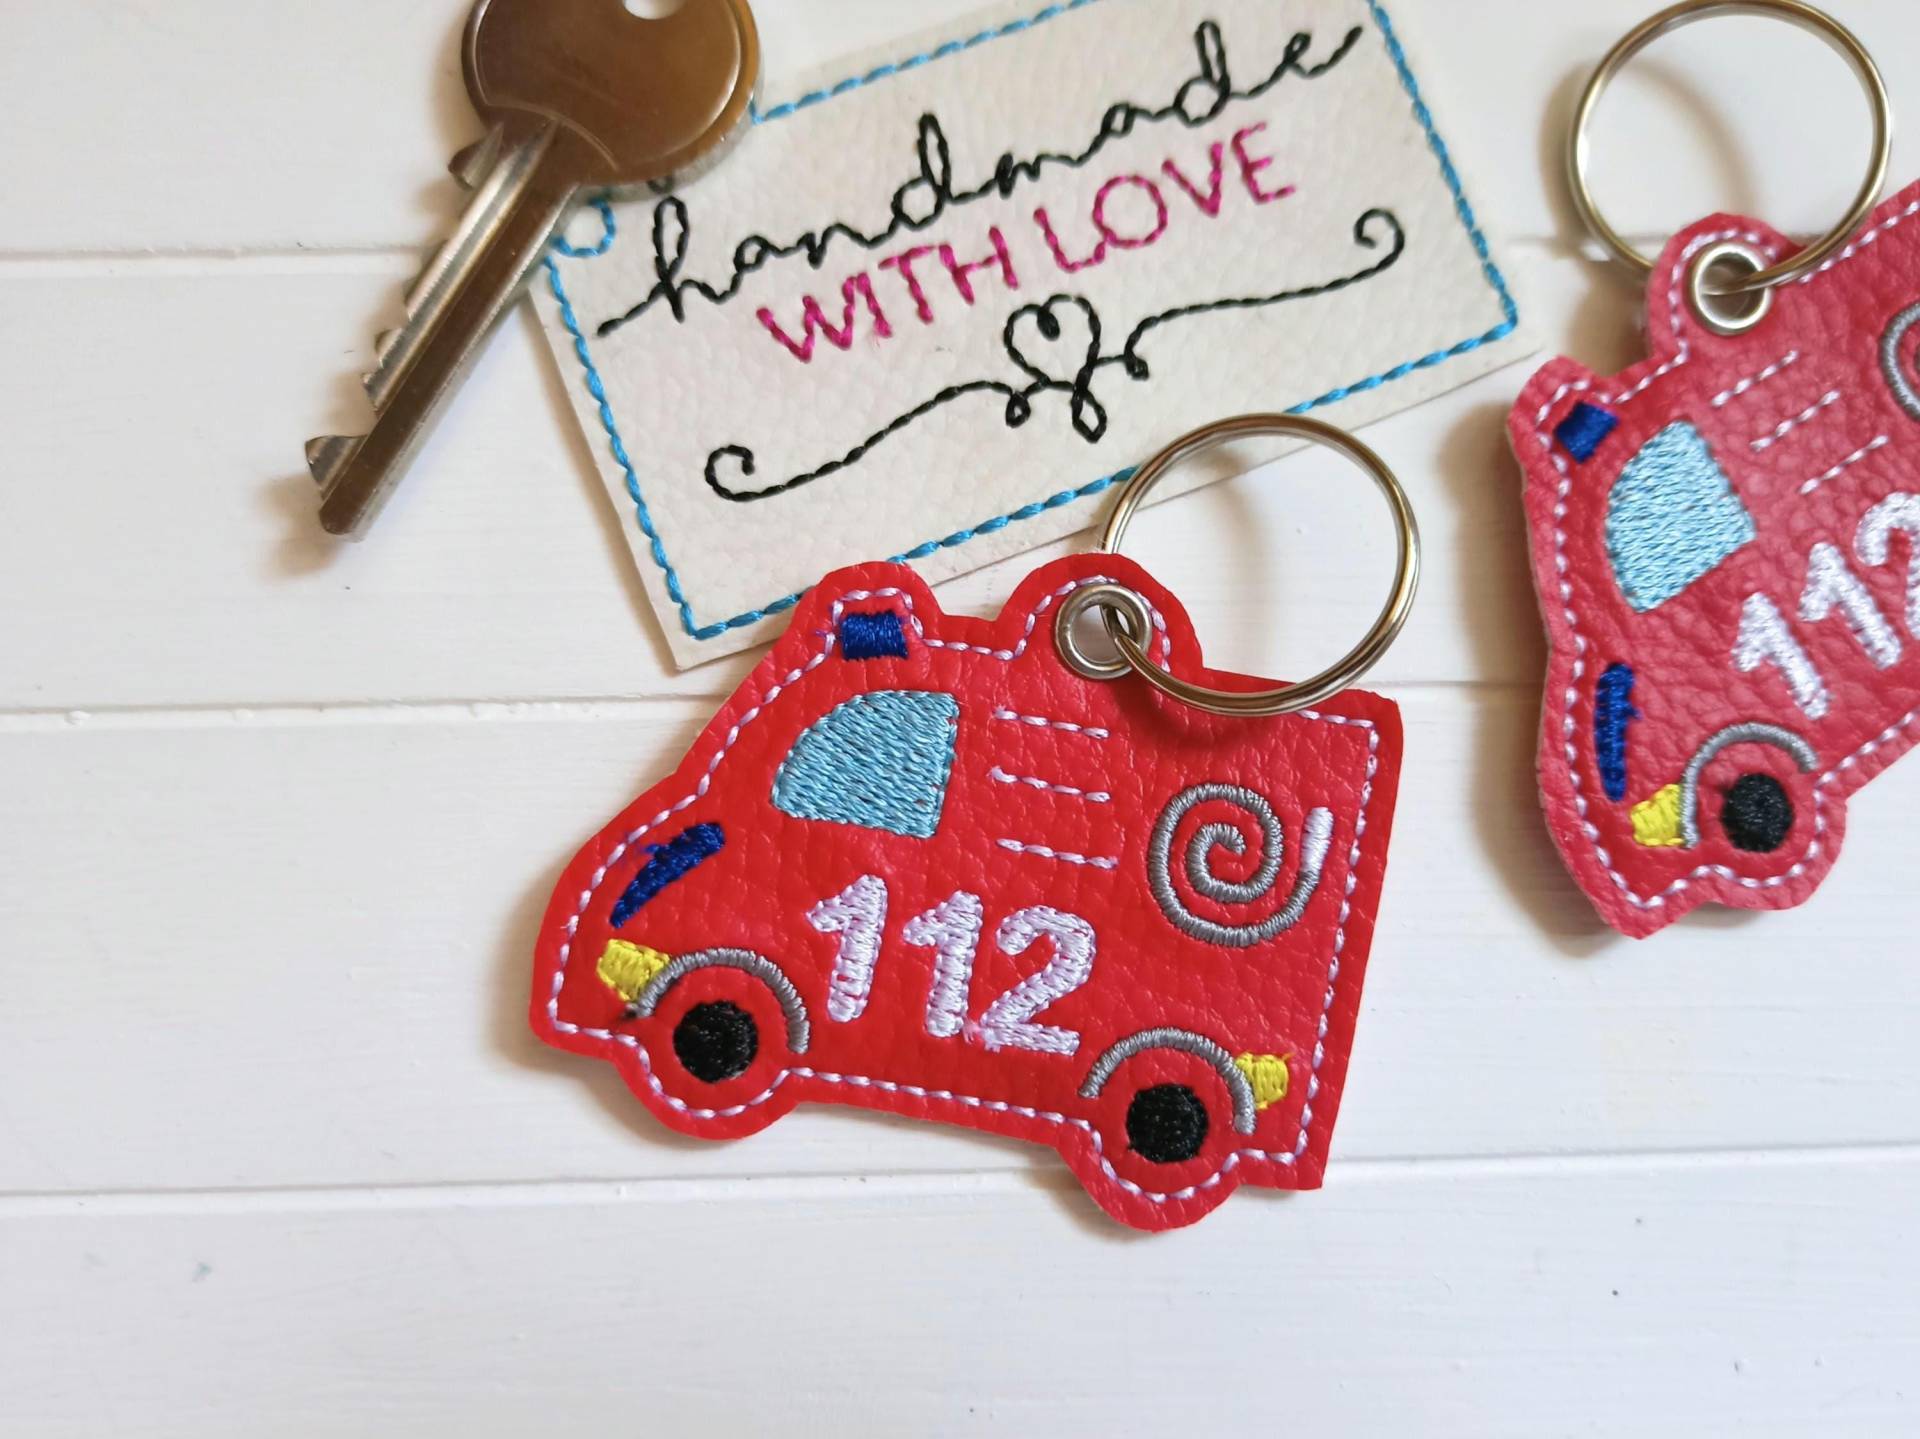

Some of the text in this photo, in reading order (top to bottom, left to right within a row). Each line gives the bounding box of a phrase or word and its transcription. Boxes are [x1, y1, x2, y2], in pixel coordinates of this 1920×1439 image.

[598, 21, 1363, 338] handmade
[756, 122, 1296, 362] WITH LOVE
[806, 874, 1097, 1056] 112
